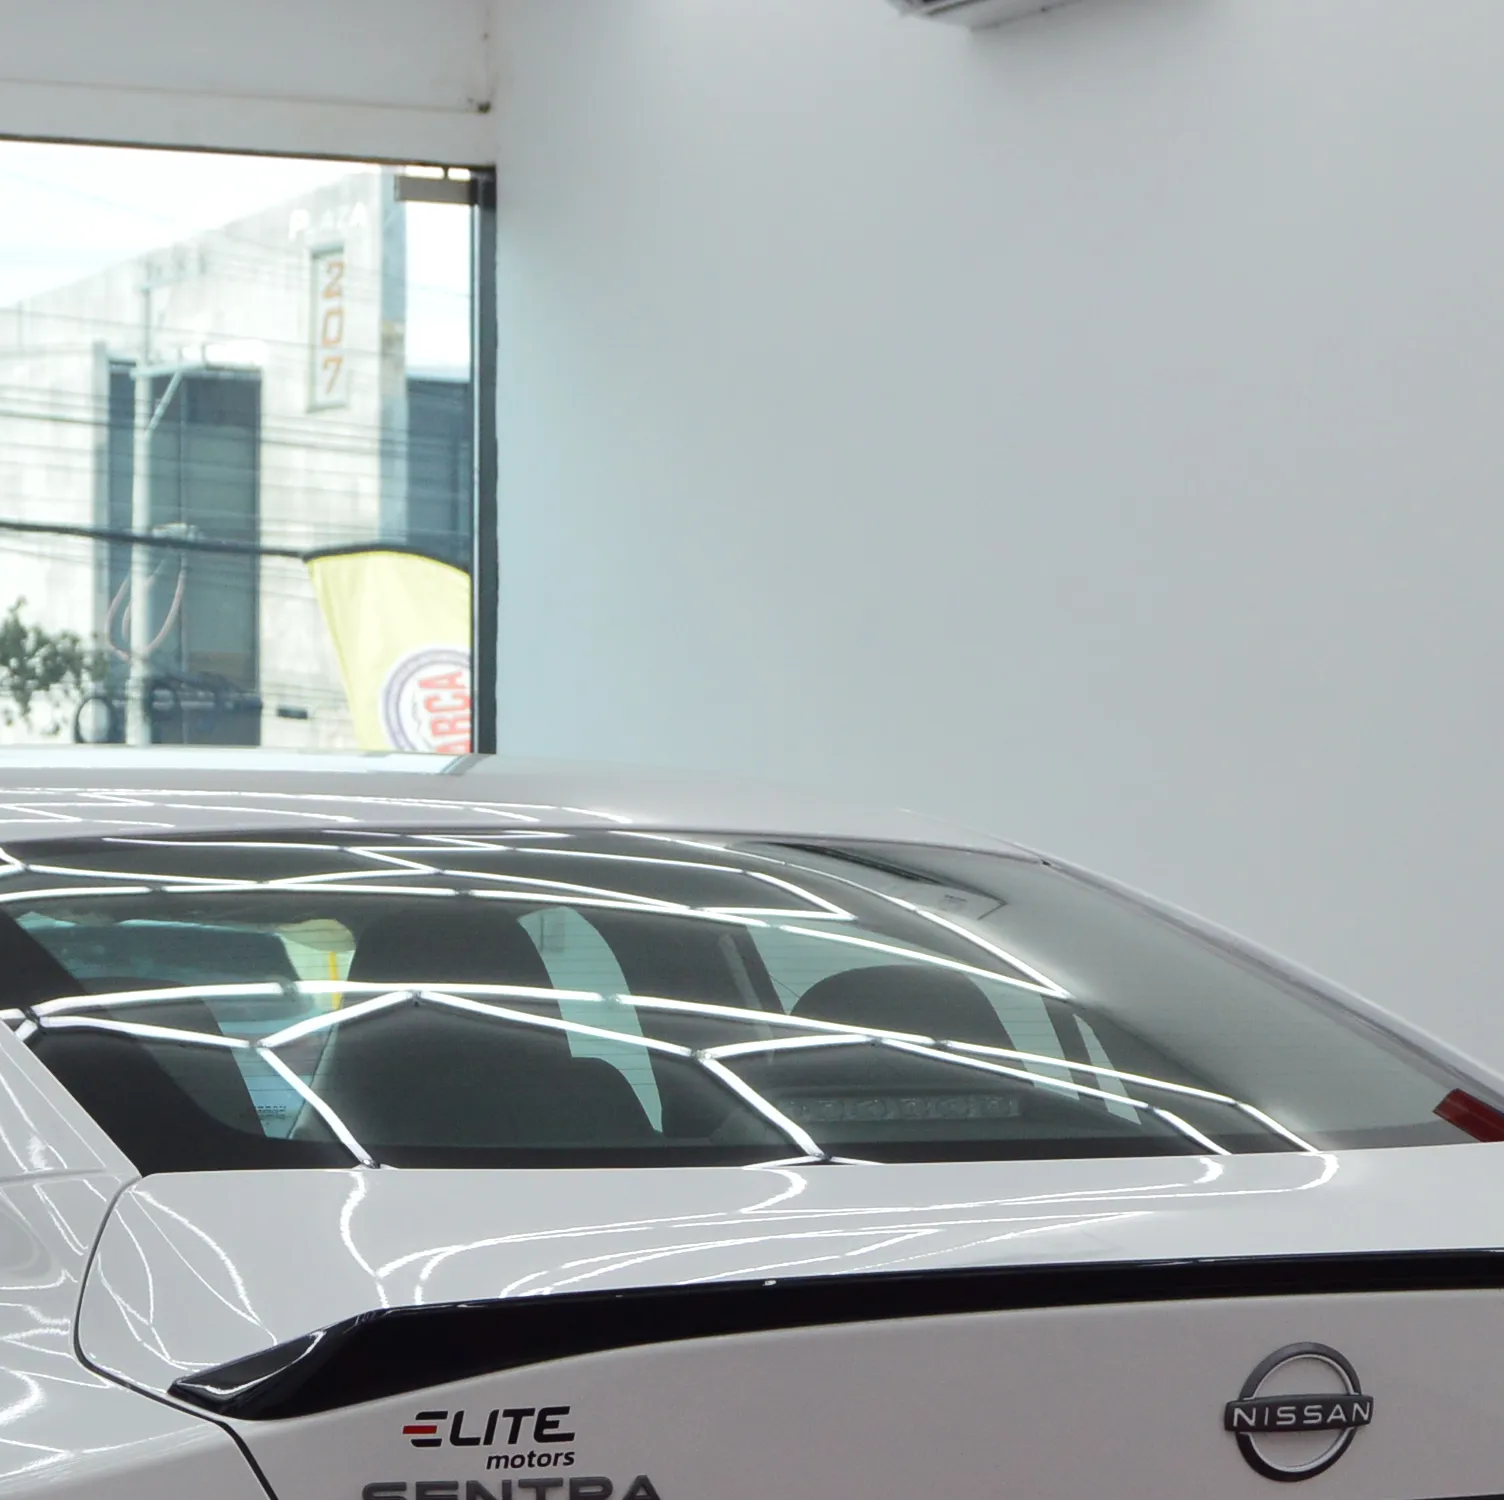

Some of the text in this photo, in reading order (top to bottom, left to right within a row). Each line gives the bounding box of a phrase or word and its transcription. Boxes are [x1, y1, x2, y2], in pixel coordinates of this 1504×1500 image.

[321, 259, 345, 395] 207
[402, 1405, 576, 1448] ELITE
[1232, 1401, 1371, 1428] NISSAN
[485, 1450, 576, 1471] motors
